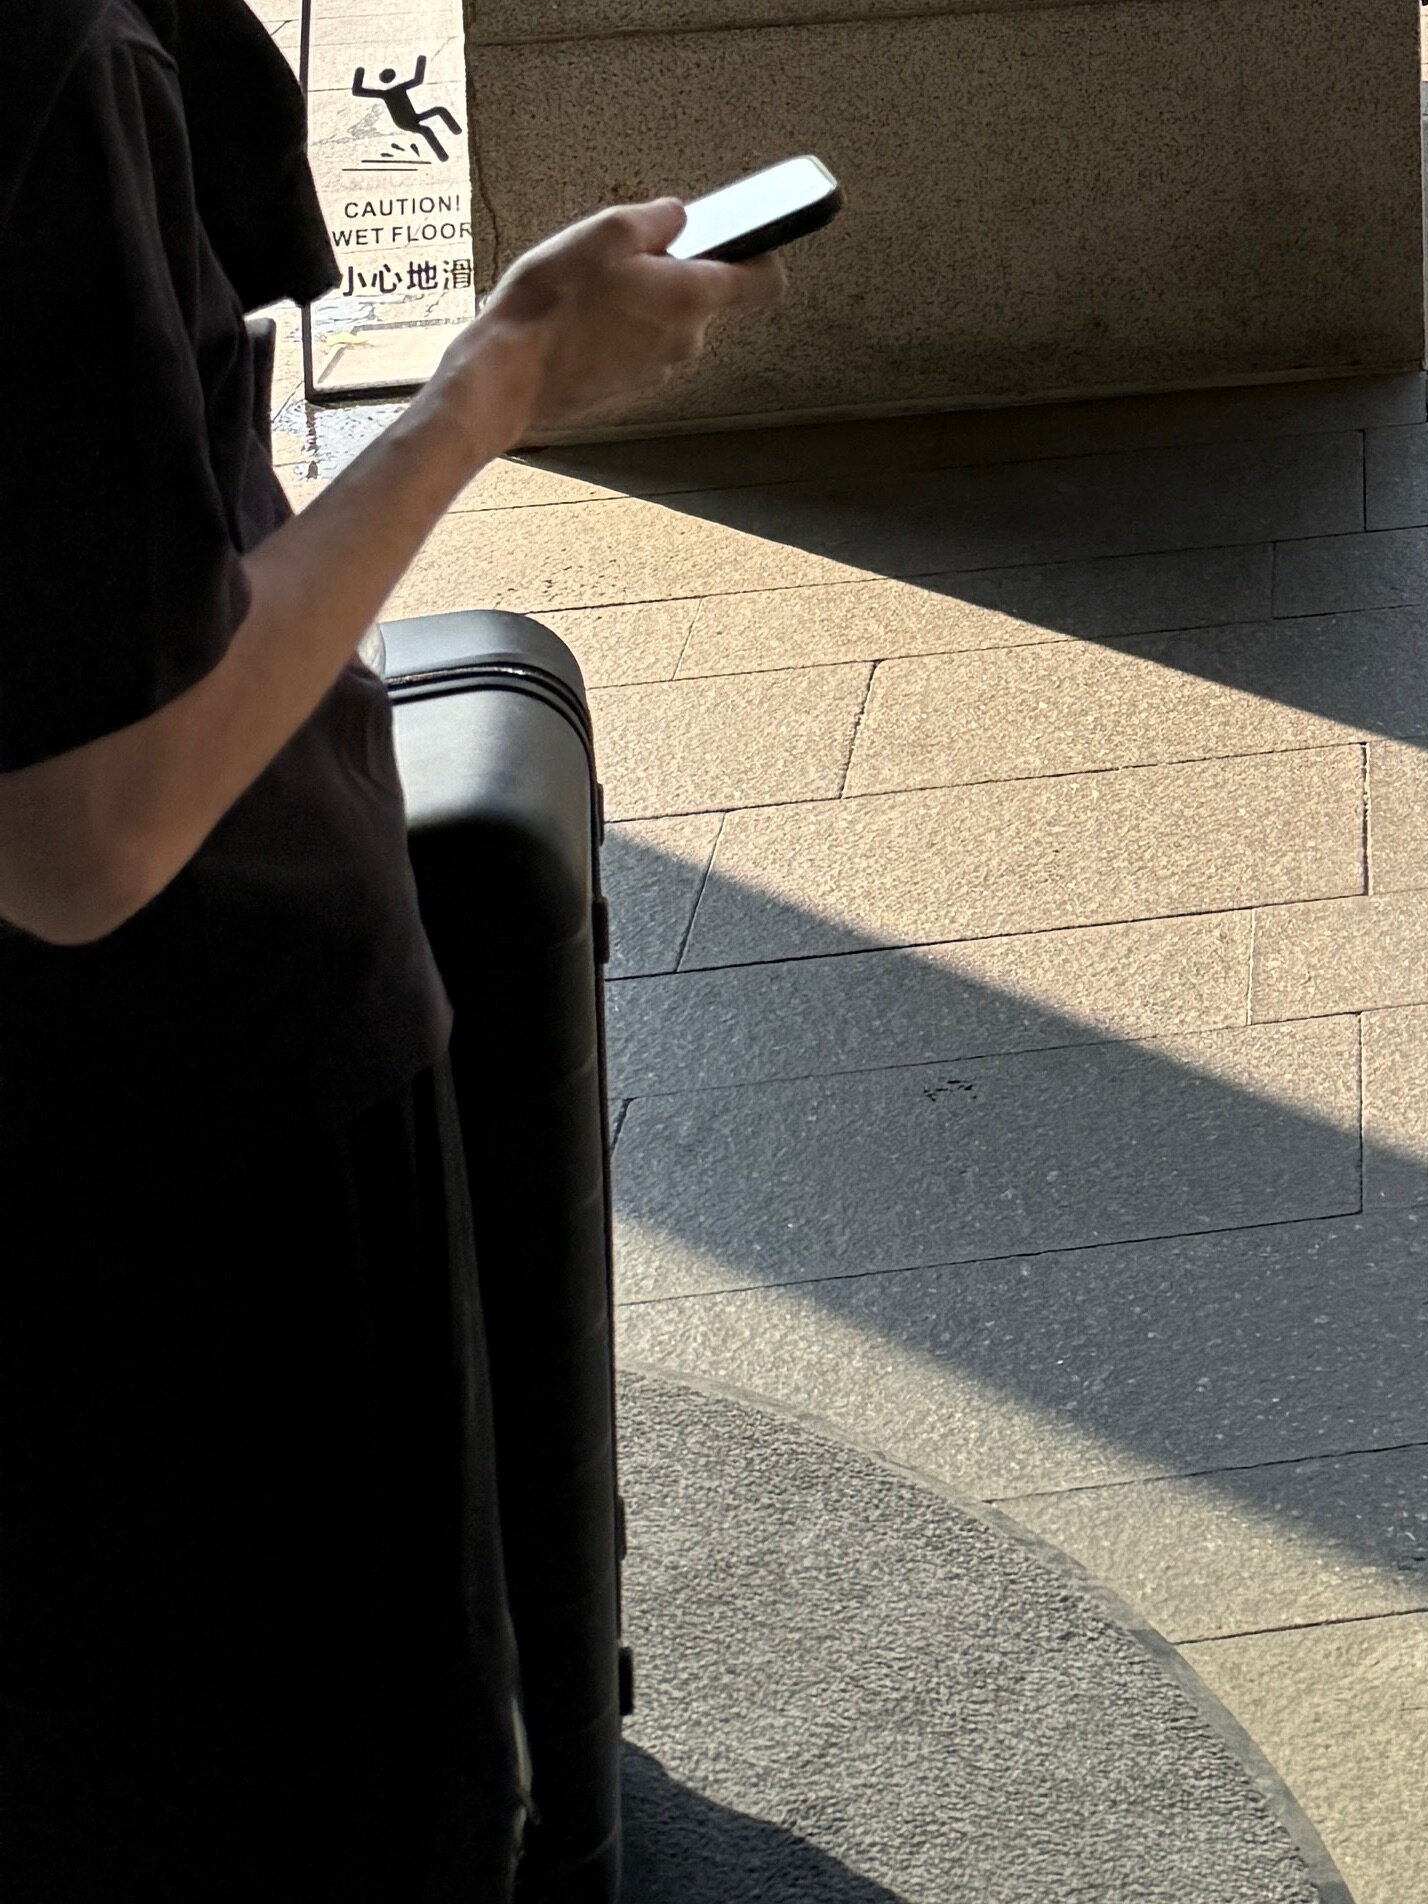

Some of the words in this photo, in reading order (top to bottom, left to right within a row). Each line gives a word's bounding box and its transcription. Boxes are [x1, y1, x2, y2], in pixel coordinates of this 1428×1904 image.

[344, 194, 460, 219] CAUTION!
[332, 227, 384, 247] WET
[392, 222, 472, 243] FLOOR
[342, 258, 472, 297] 小心地滑
